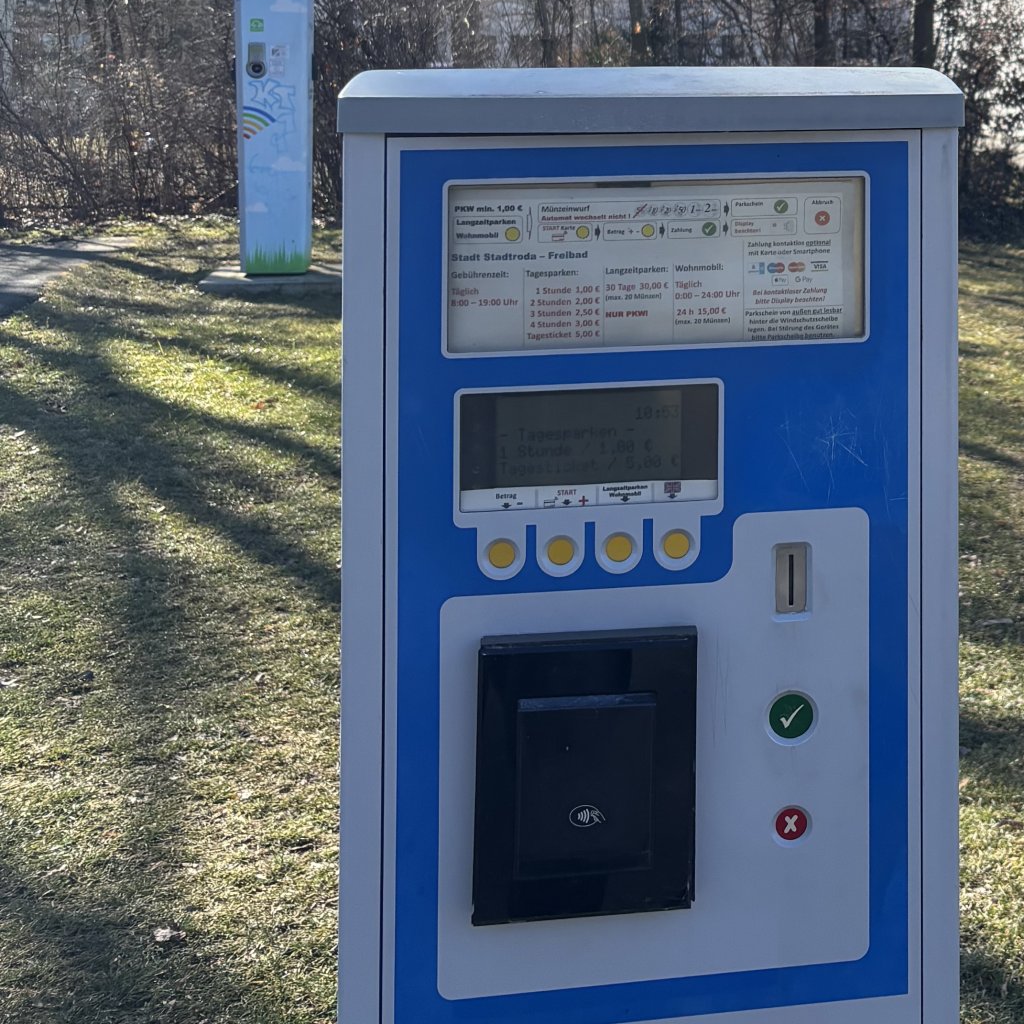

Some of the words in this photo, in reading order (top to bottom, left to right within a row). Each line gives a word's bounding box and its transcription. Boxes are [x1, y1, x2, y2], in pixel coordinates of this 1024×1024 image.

[497, 205, 515, 213] 1,00
[541, 205, 590, 213] Münzeinwurf
[456, 219, 516, 227] Langzeitparken
[451, 253, 480, 262] Stadt
[484, 252, 537, 261] Stadtroda
[548, 251, 588, 260] Freibad
[605, 266, 668, 276] Langzeitparken:
[675, 264, 724, 272] Wohnmobil:
[451, 271, 509, 279] Gebührenzeit:
[525, 269, 579, 278] Tagesparken:
[617, 284, 635, 292] Tage
[639, 282, 662, 290] 30,00
[663, 281, 669, 289] €
[675, 280, 702, 289] Täglich
[451, 288, 479, 296] Täglich
[536, 287, 540, 295] 1
[542, 286, 571, 294] Stunde
[575, 286, 593, 294] 1,00
[675, 292, 693, 300] 0:00
[701, 291, 723, 299] 24:00
[725, 290, 740, 298] Uhr
[634, 292, 662, 300] Münzen)
[503, 298, 518, 306] Uhr
[537, 298, 572, 306] Stunden
[575, 297, 593, 306] 2,00
[595, 297, 600, 305] €
[537, 309, 572, 317] Stunden
[575, 309, 593, 317] 2,50
[677, 308, 686, 316] 24
[698, 307, 719, 316] 15,00
[537, 320, 572, 328] Stunden
[575, 319, 593, 328] 3,00
[595, 319, 600, 327] €
[527, 331, 572, 341] Tagesticket
[575, 330, 593, 339] 5,00
[518, 427, 617, 442] Tagesparken
[518, 444, 573, 458] Stunde
[600, 440, 634, 454] 1,00
[500, 460, 599, 476] Tagesticket
